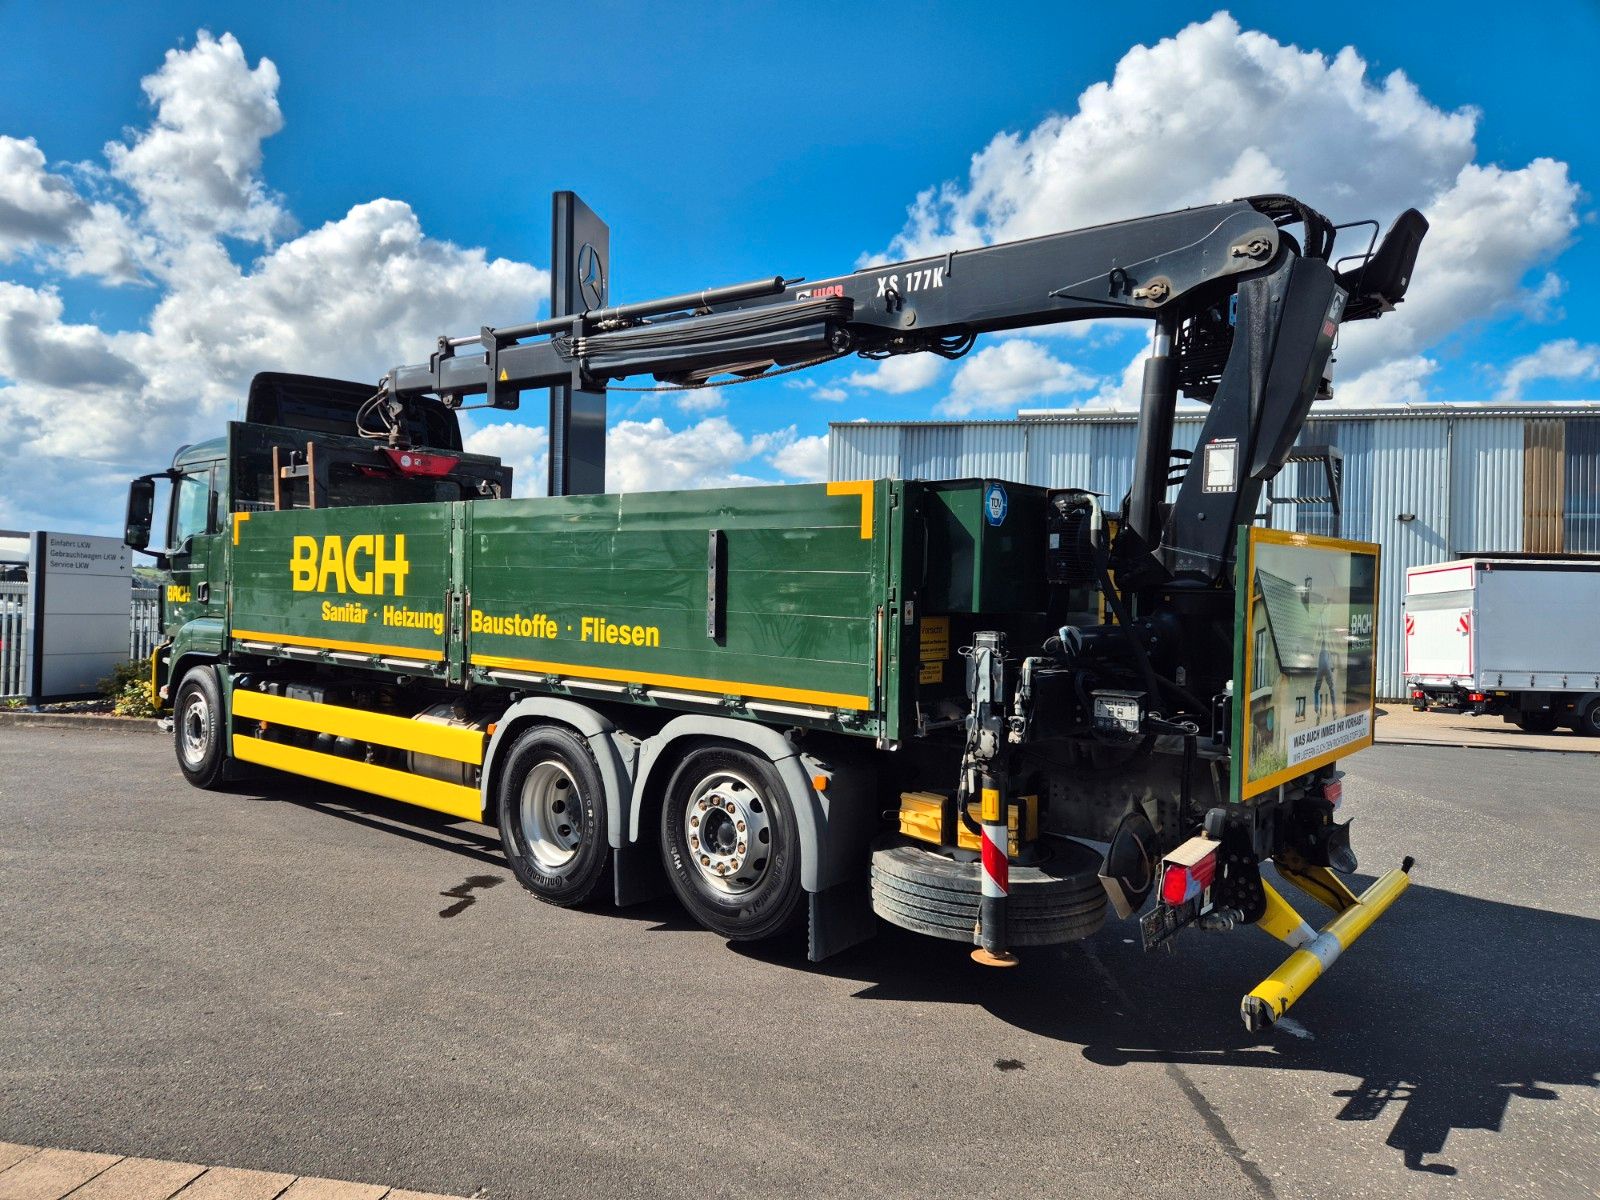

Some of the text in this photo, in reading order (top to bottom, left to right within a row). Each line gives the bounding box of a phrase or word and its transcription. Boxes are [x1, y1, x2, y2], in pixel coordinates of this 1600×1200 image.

[877, 267, 943, 297] XS 177K
[50, 539, 75, 548] Einfahrt
[50, 550, 117, 561] Gebrauchtwagen LKW
[290, 534, 409, 596] BACH
[167, 585, 191, 603] BACH
[322, 601, 660, 648] Sanitär Heizung Baustoffe Fliesen
[1351, 613, 1372, 635] BACH
[1294, 735, 1305, 748] WAS
[525, 866, 563, 888] Continental
